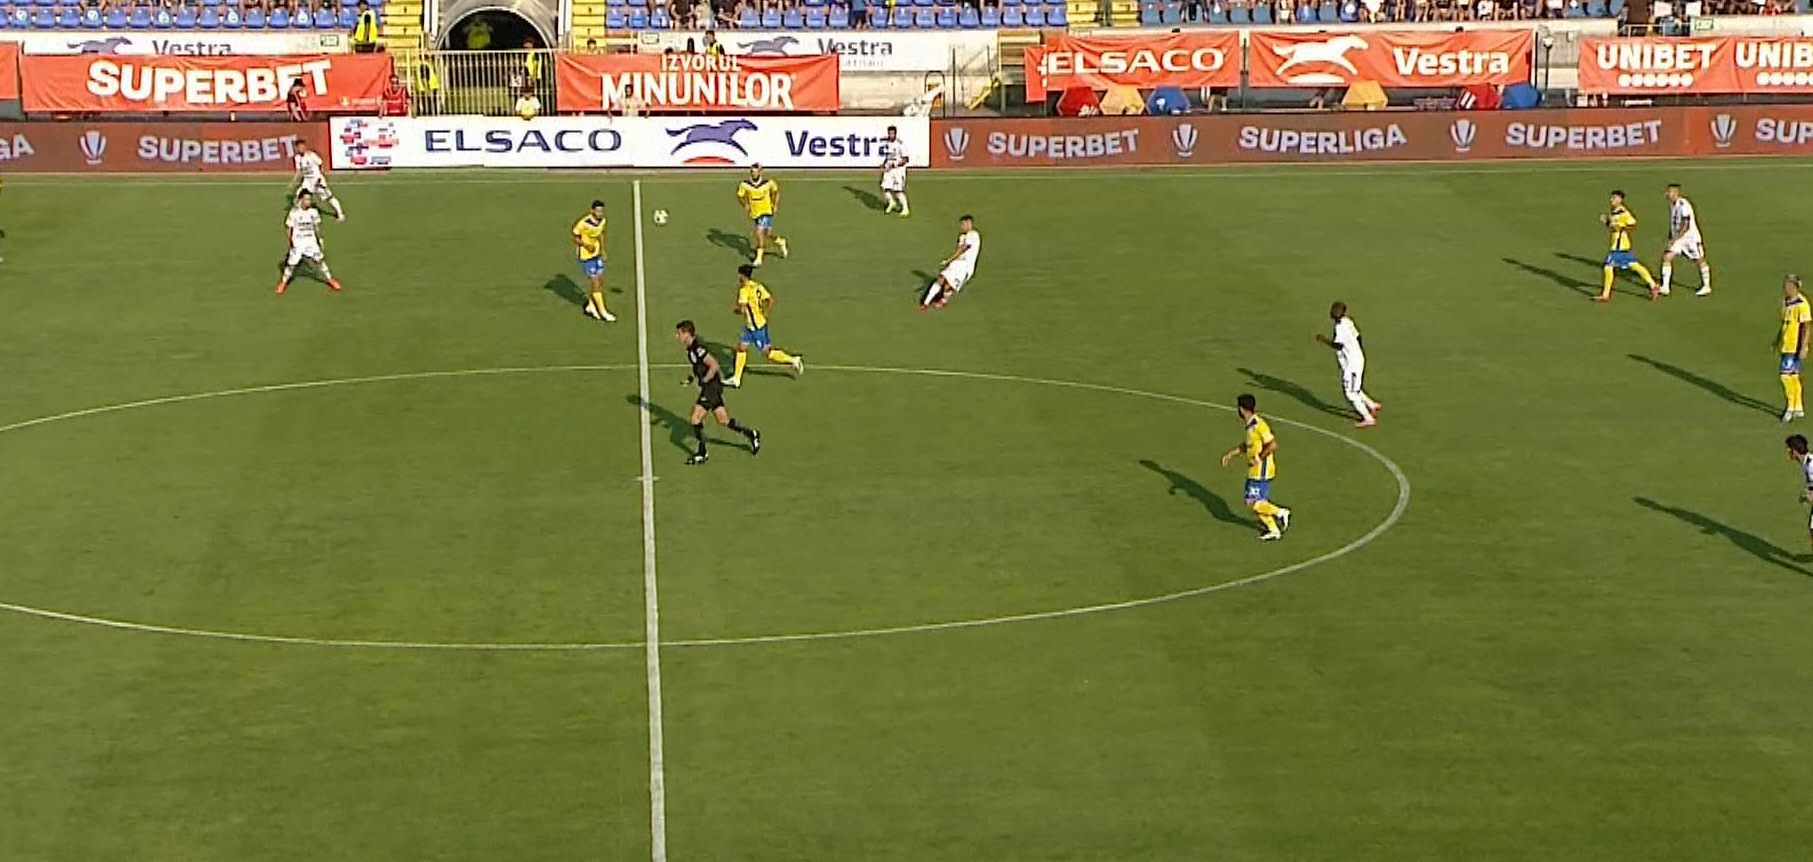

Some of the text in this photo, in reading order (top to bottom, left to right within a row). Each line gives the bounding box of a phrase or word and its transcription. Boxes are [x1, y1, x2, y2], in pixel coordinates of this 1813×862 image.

[818, 37, 893, 55] Vestra
[1597, 43, 1716, 70] UNIBET
[1736, 43, 1813, 68] UNIB
[661, 54, 741, 71] IZVORUL
[1050, 48, 1223, 75] ELSACO
[1394, 47, 1509, 75] Vestra
[88, 60, 331, 104] SUPERBET
[602, 72, 793, 109] MINUNILOR
[425, 130, 621, 152] ELSACO
[988, 129, 1139, 158] SUPERBET
[1240, 125, 1406, 154] SUPERLIGA
[1506, 121, 1661, 149] SUPERBET
[1756, 118, 1813, 144] SUP
[139, 135, 299, 163] SUPERBET
